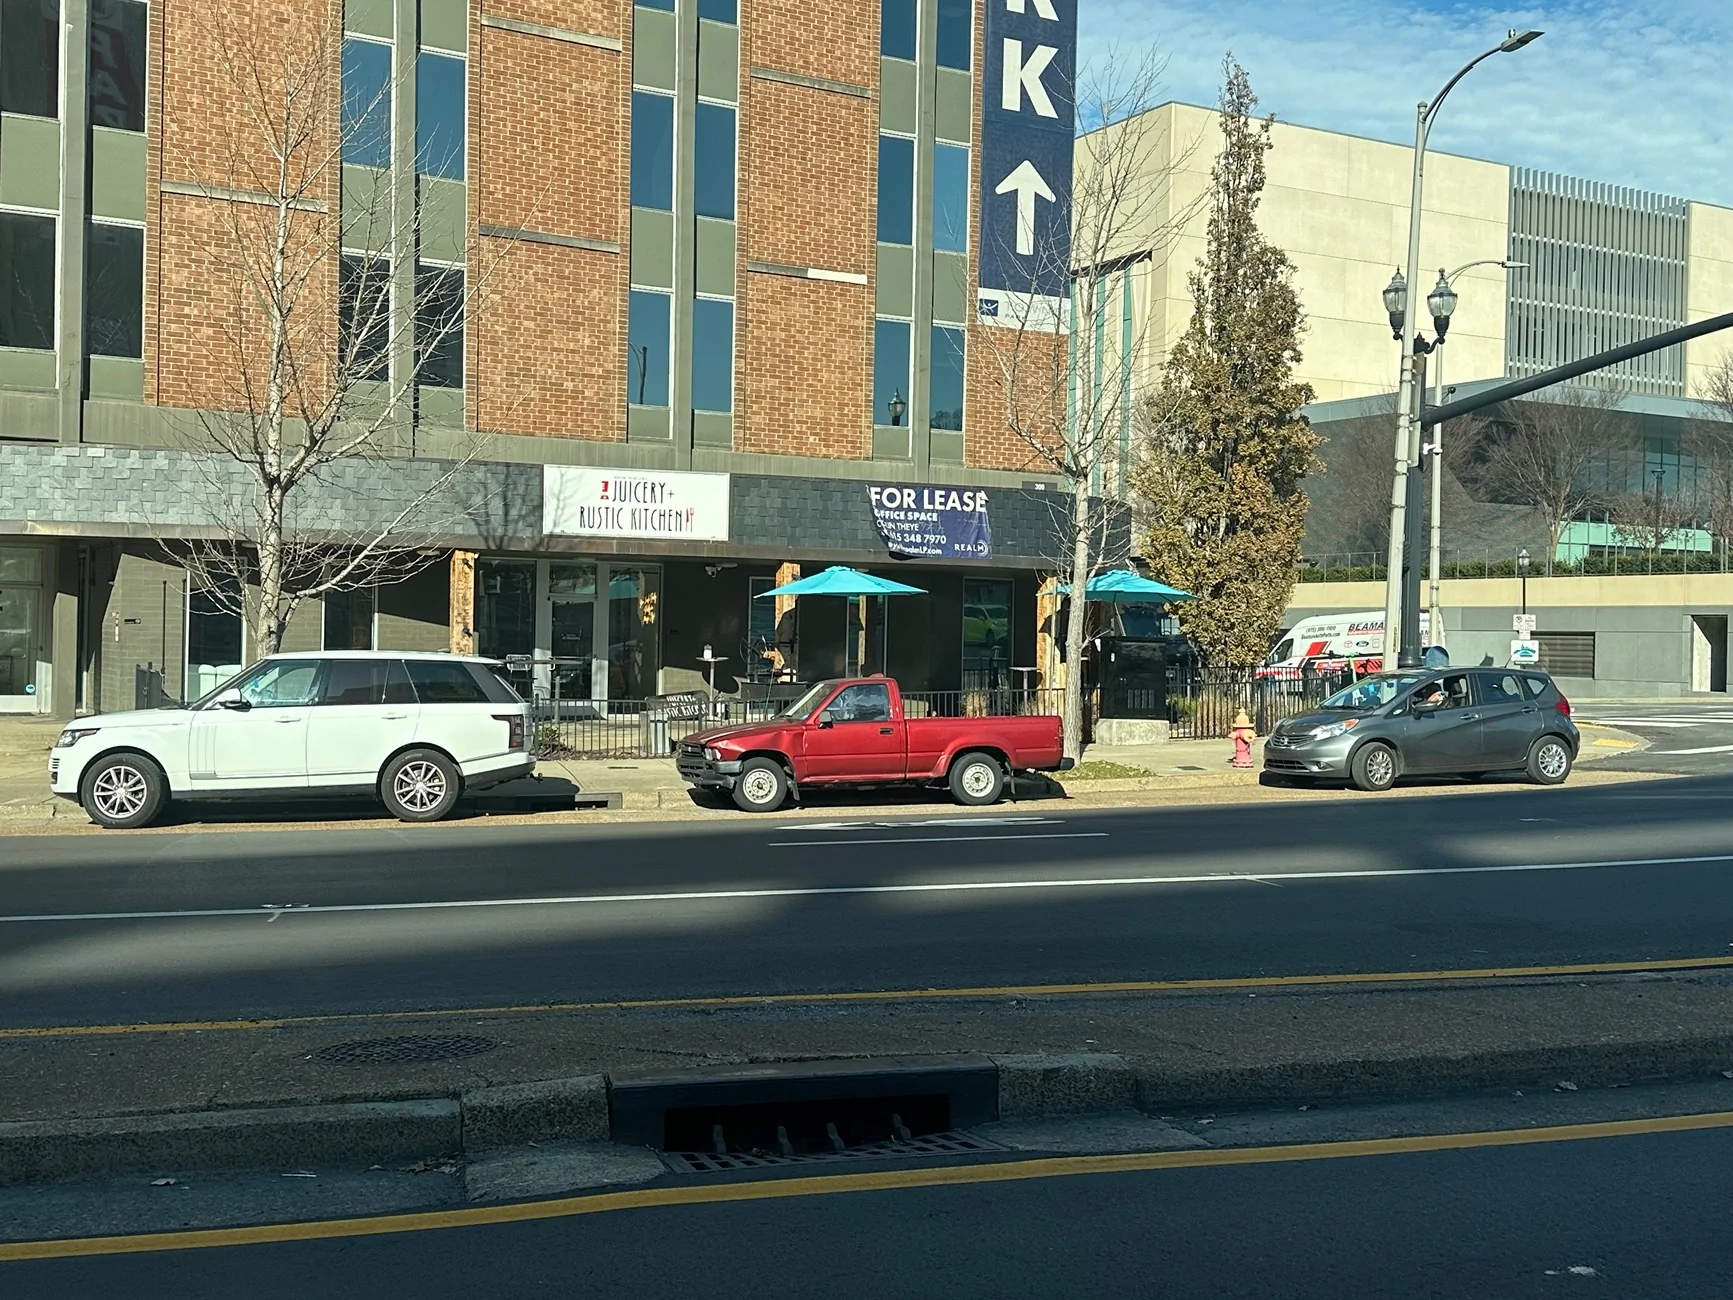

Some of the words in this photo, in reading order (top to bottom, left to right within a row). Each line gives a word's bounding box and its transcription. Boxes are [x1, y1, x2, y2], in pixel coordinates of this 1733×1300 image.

[870, 487, 917, 509] FOR
[923, 489, 987, 512] LEASE
[580, 506, 623, 530] RUSTIC
[630, 508, 682, 532] KITCHEN
[907, 511, 938, 521] SPACE
[896, 522, 919, 531] THEYE
[903, 533, 921, 543] 348
[923, 534, 947, 544] 7970
[954, 543, 985, 552] REALM
[1348, 621, 1385, 631] BEAMA
